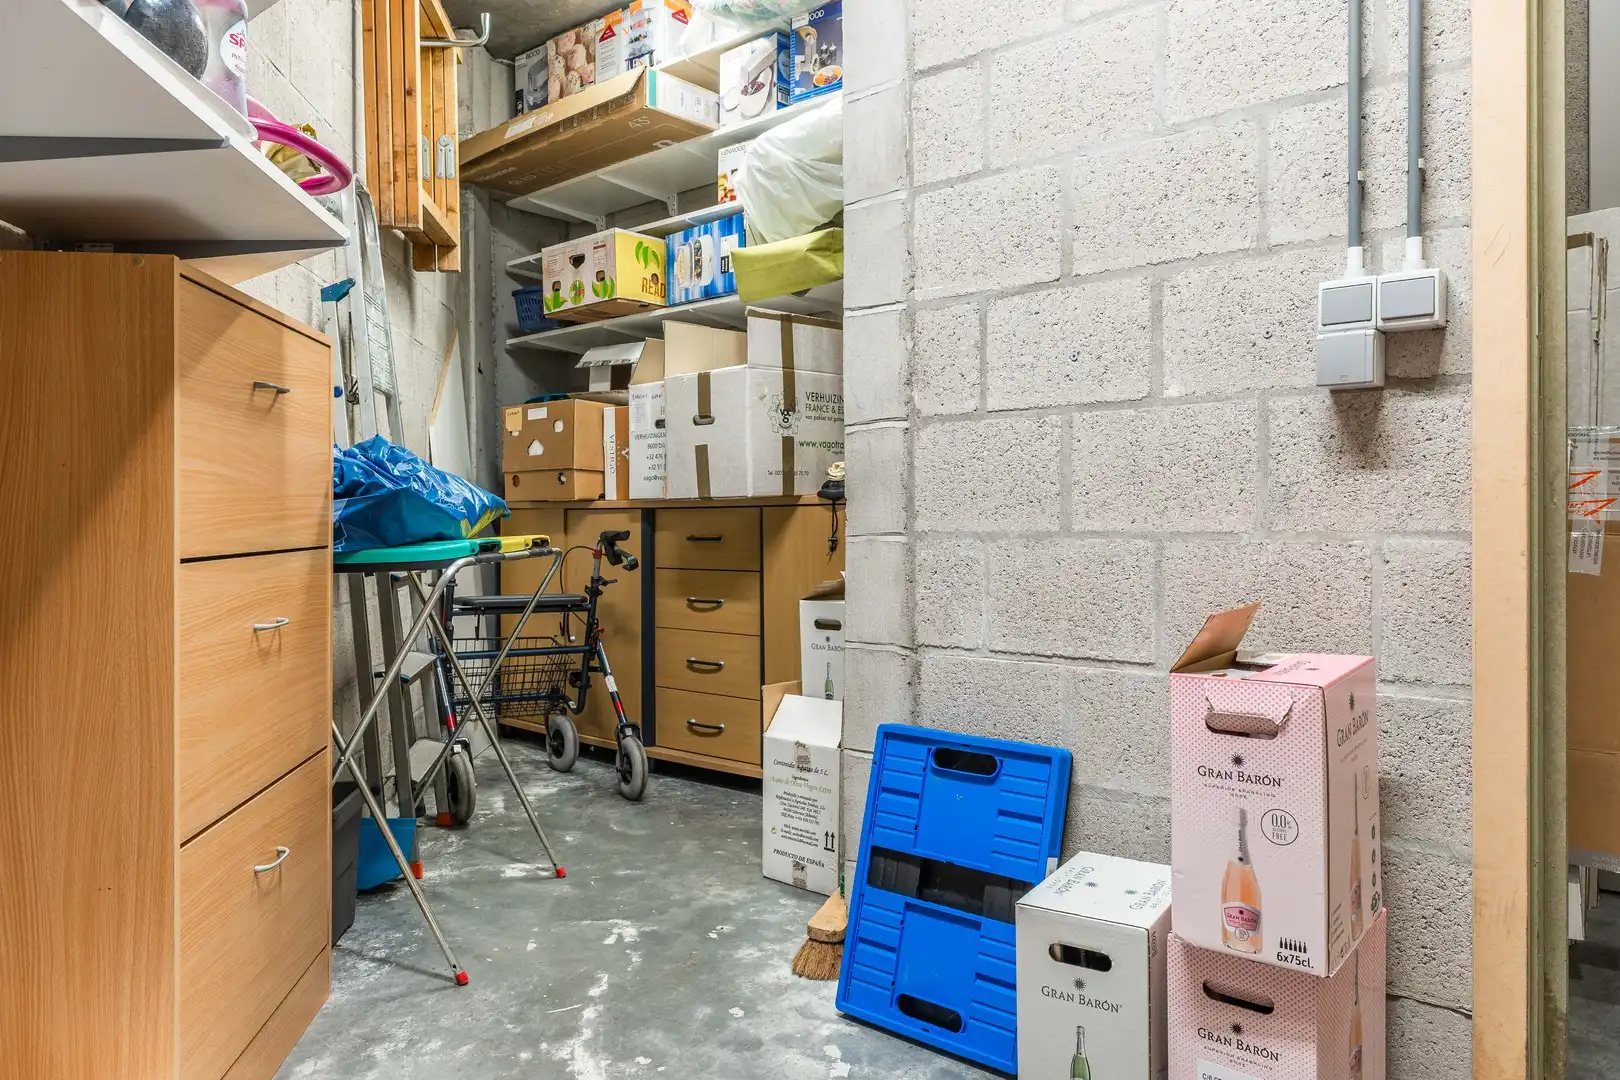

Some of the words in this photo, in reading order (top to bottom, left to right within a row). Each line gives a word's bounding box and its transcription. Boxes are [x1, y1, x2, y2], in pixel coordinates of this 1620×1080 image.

[805, 403, 830, 414] FRANCE
[1197, 765, 1233, 781] GRAN
[1237, 770, 1281, 788] BARÓN
[1272, 832, 1288, 841] FREE
[773, 848, 798, 860] PRODUCTO
[798, 855, 806, 863] DE
[1276, 951, 1315, 969] 6x75cl.
[1041, 985, 1075, 1002] GRAN
[1078, 993, 1119, 1013] BARÓN
[1197, 1027, 1232, 1047] GRAN
[1236, 1038, 1279, 1062] BARÓN
